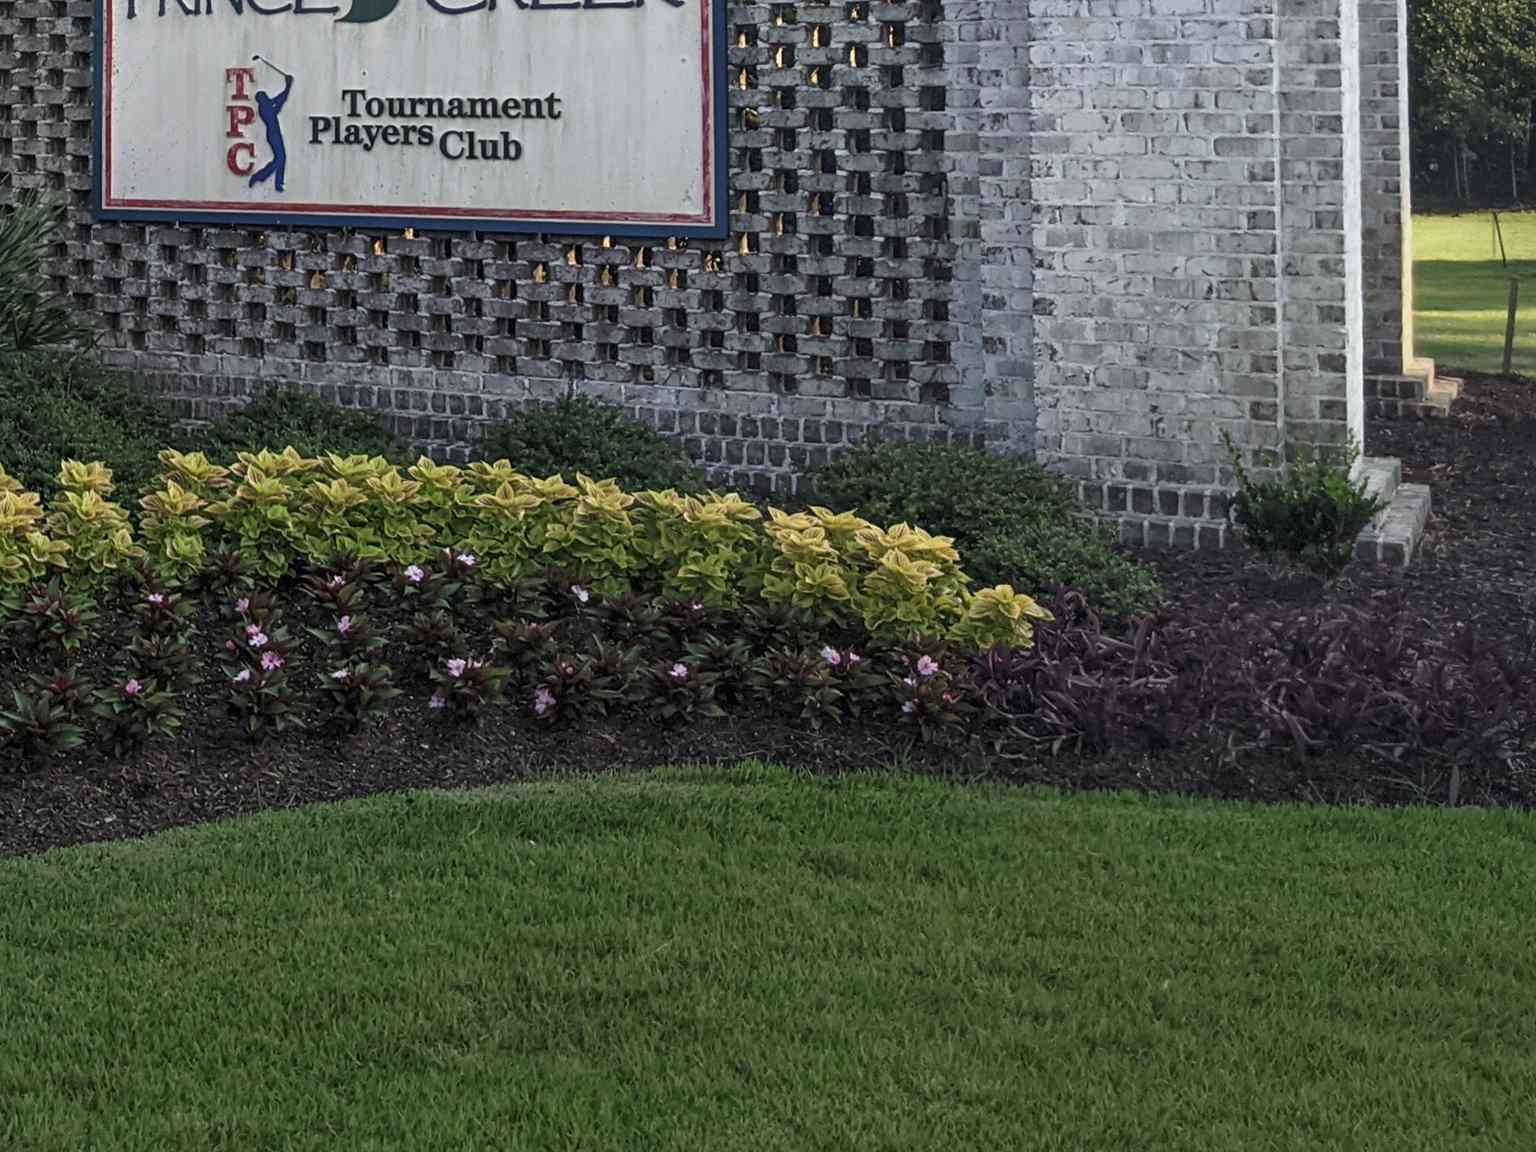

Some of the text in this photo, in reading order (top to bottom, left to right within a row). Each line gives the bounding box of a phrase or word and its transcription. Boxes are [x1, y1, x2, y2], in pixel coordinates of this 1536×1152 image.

[225, 67, 256, 177] TPC
[342, 89, 562, 120] Tournament
[309, 115, 522, 161] Players Club
